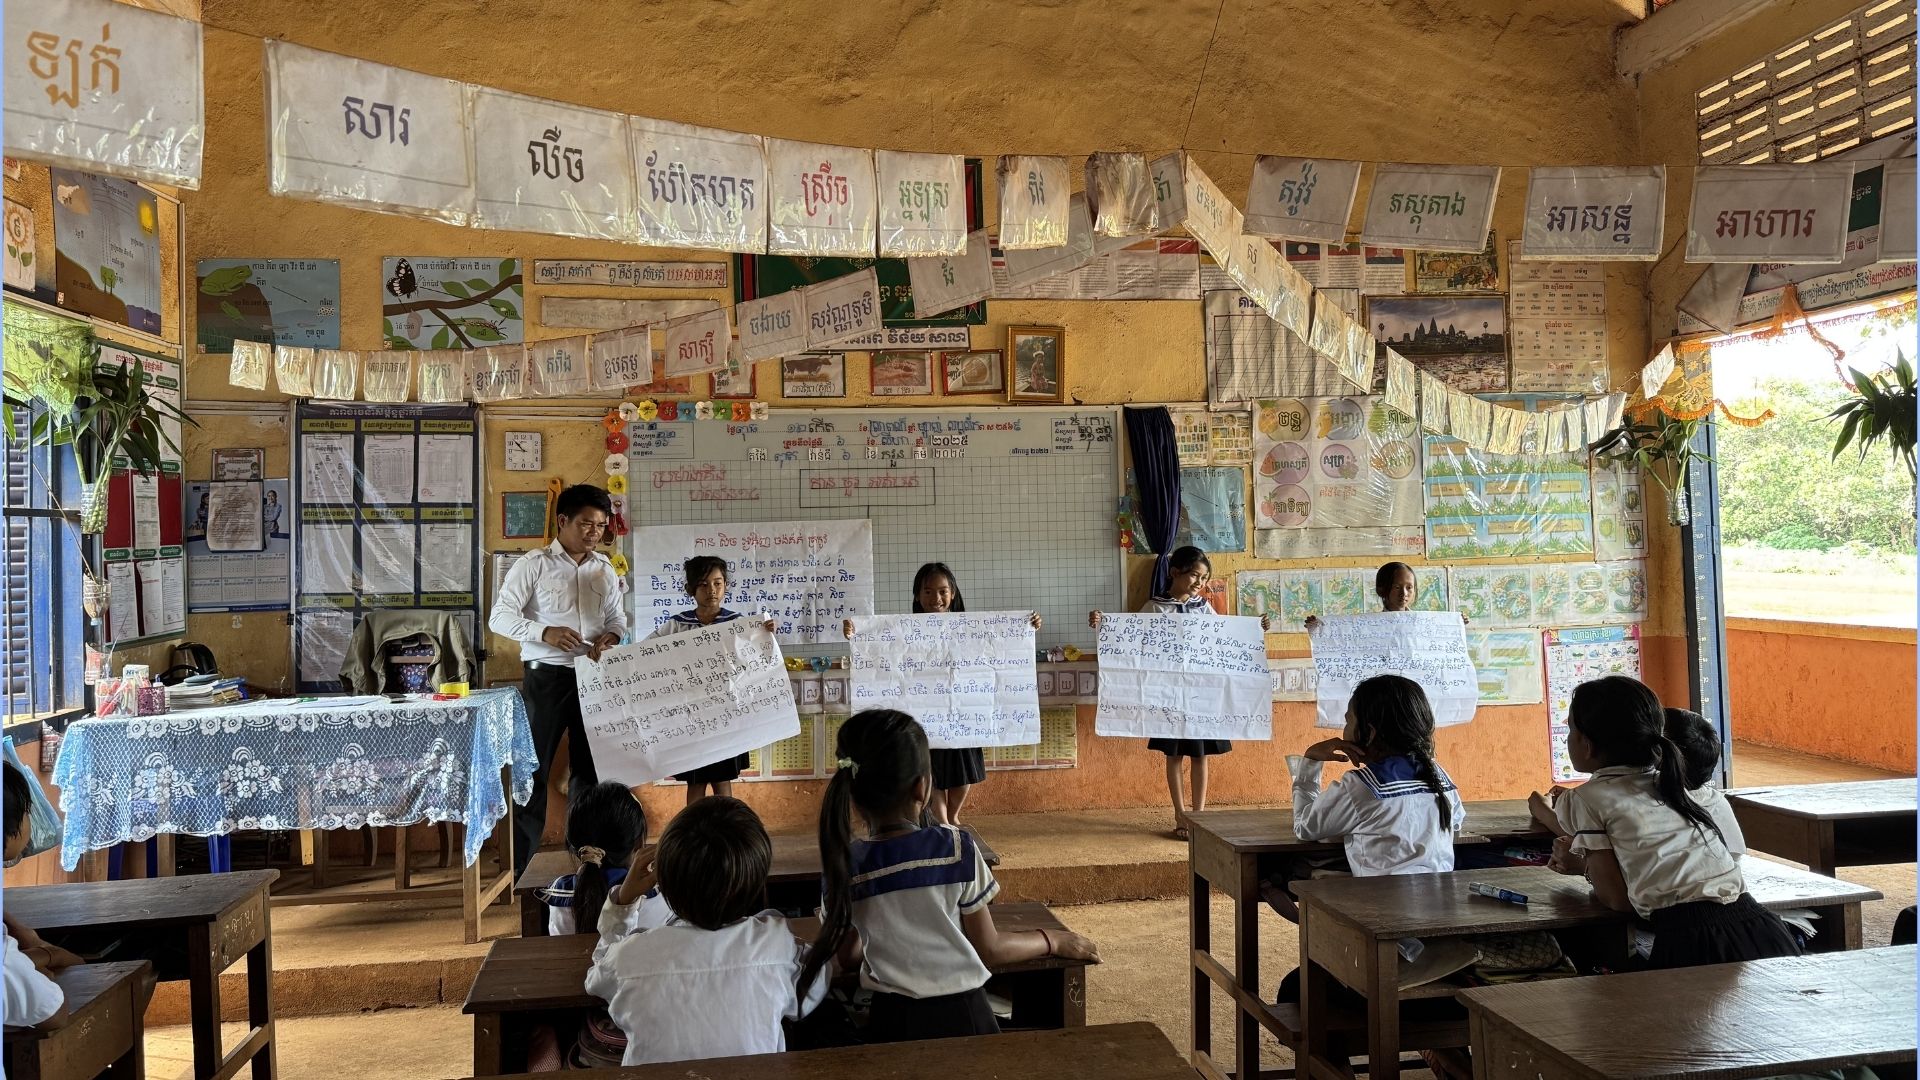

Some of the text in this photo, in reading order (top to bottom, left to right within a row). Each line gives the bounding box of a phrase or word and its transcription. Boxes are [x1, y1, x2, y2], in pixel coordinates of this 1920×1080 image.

[342, 96, 411, 147] សារ
[1715, 208, 1816, 239] អាហារ
[810, 290, 873, 336] សុវណ្ណភូមិ
[678, 330, 714, 365] សាក្សី
